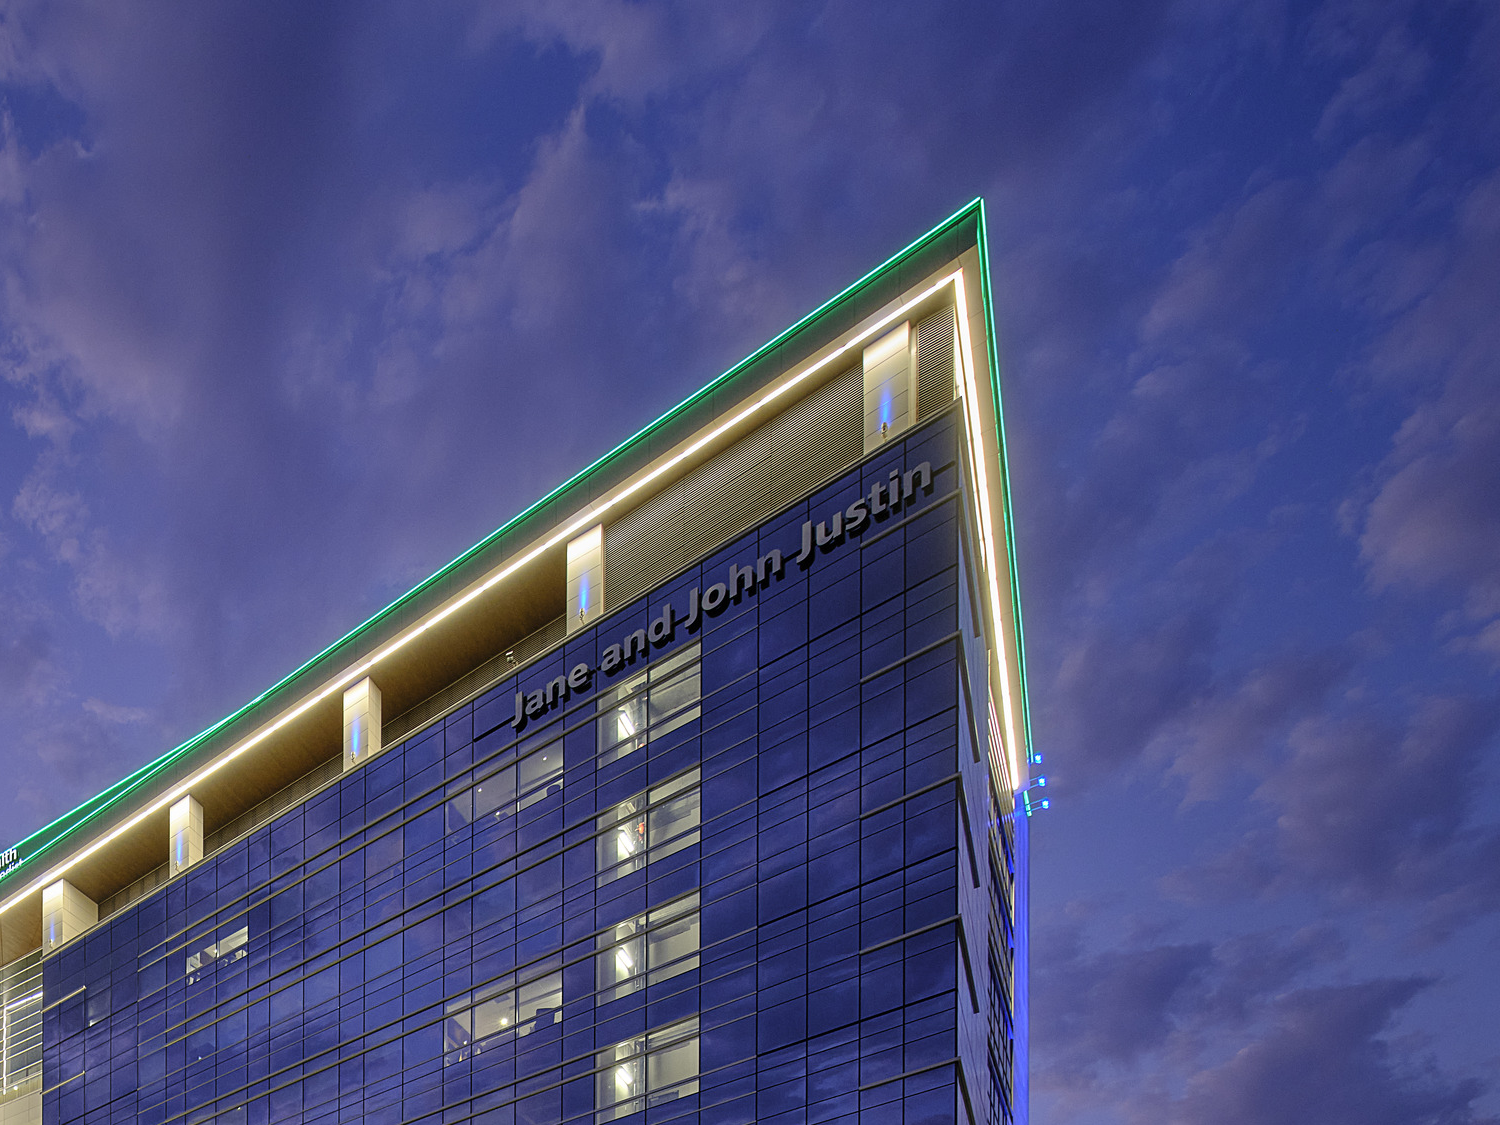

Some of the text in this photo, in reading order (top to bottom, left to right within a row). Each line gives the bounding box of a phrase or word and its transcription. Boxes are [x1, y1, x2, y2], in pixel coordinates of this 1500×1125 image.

[511, 461, 931, 728] Jane and John Justin
